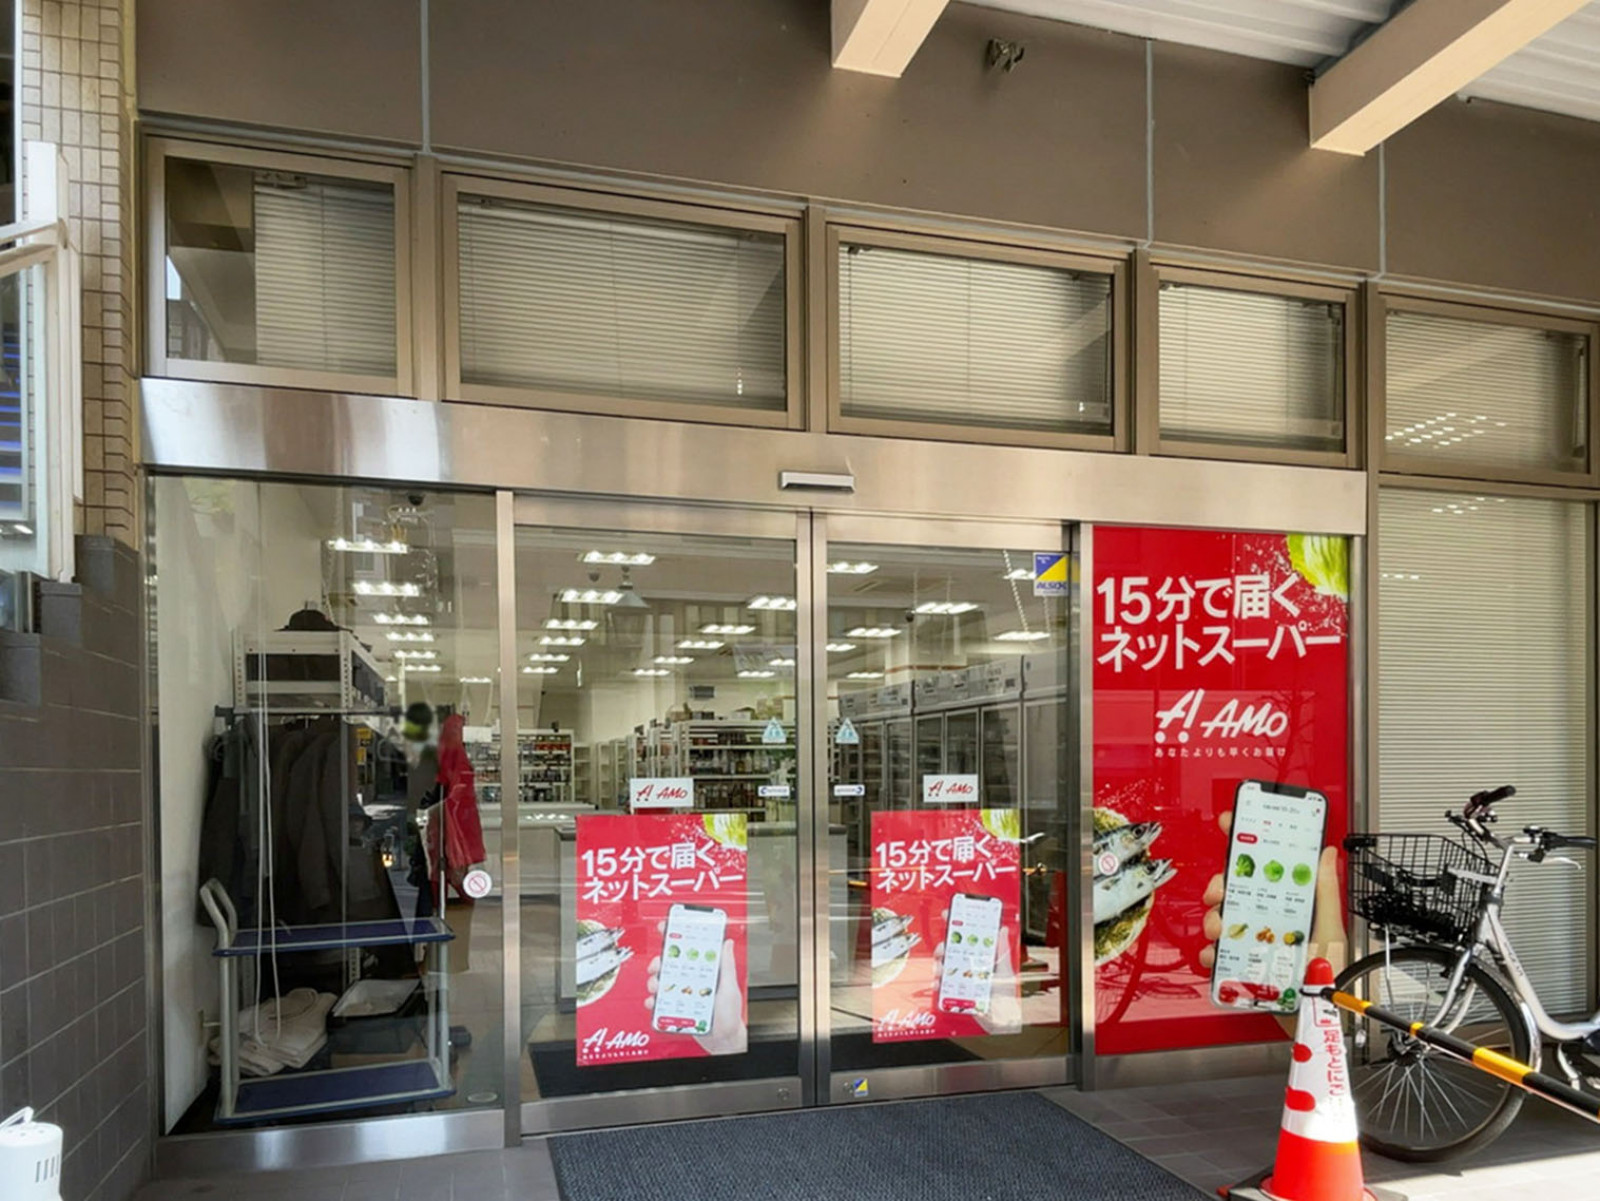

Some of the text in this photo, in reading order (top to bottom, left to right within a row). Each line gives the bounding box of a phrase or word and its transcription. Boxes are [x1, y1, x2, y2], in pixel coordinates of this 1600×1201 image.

[1097, 573, 1301, 625] 15分で届く
[1097, 620, 1341, 673] ネットスーパー
[581, 839, 716, 878] 15分で届く
[875, 834, 993, 869] 15分で届く
[581, 867, 744, 905] ネットスーパー
[875, 858, 1017, 894] ネットスーパー
[1323, 1029, 1345, 1111] 足もとにご
